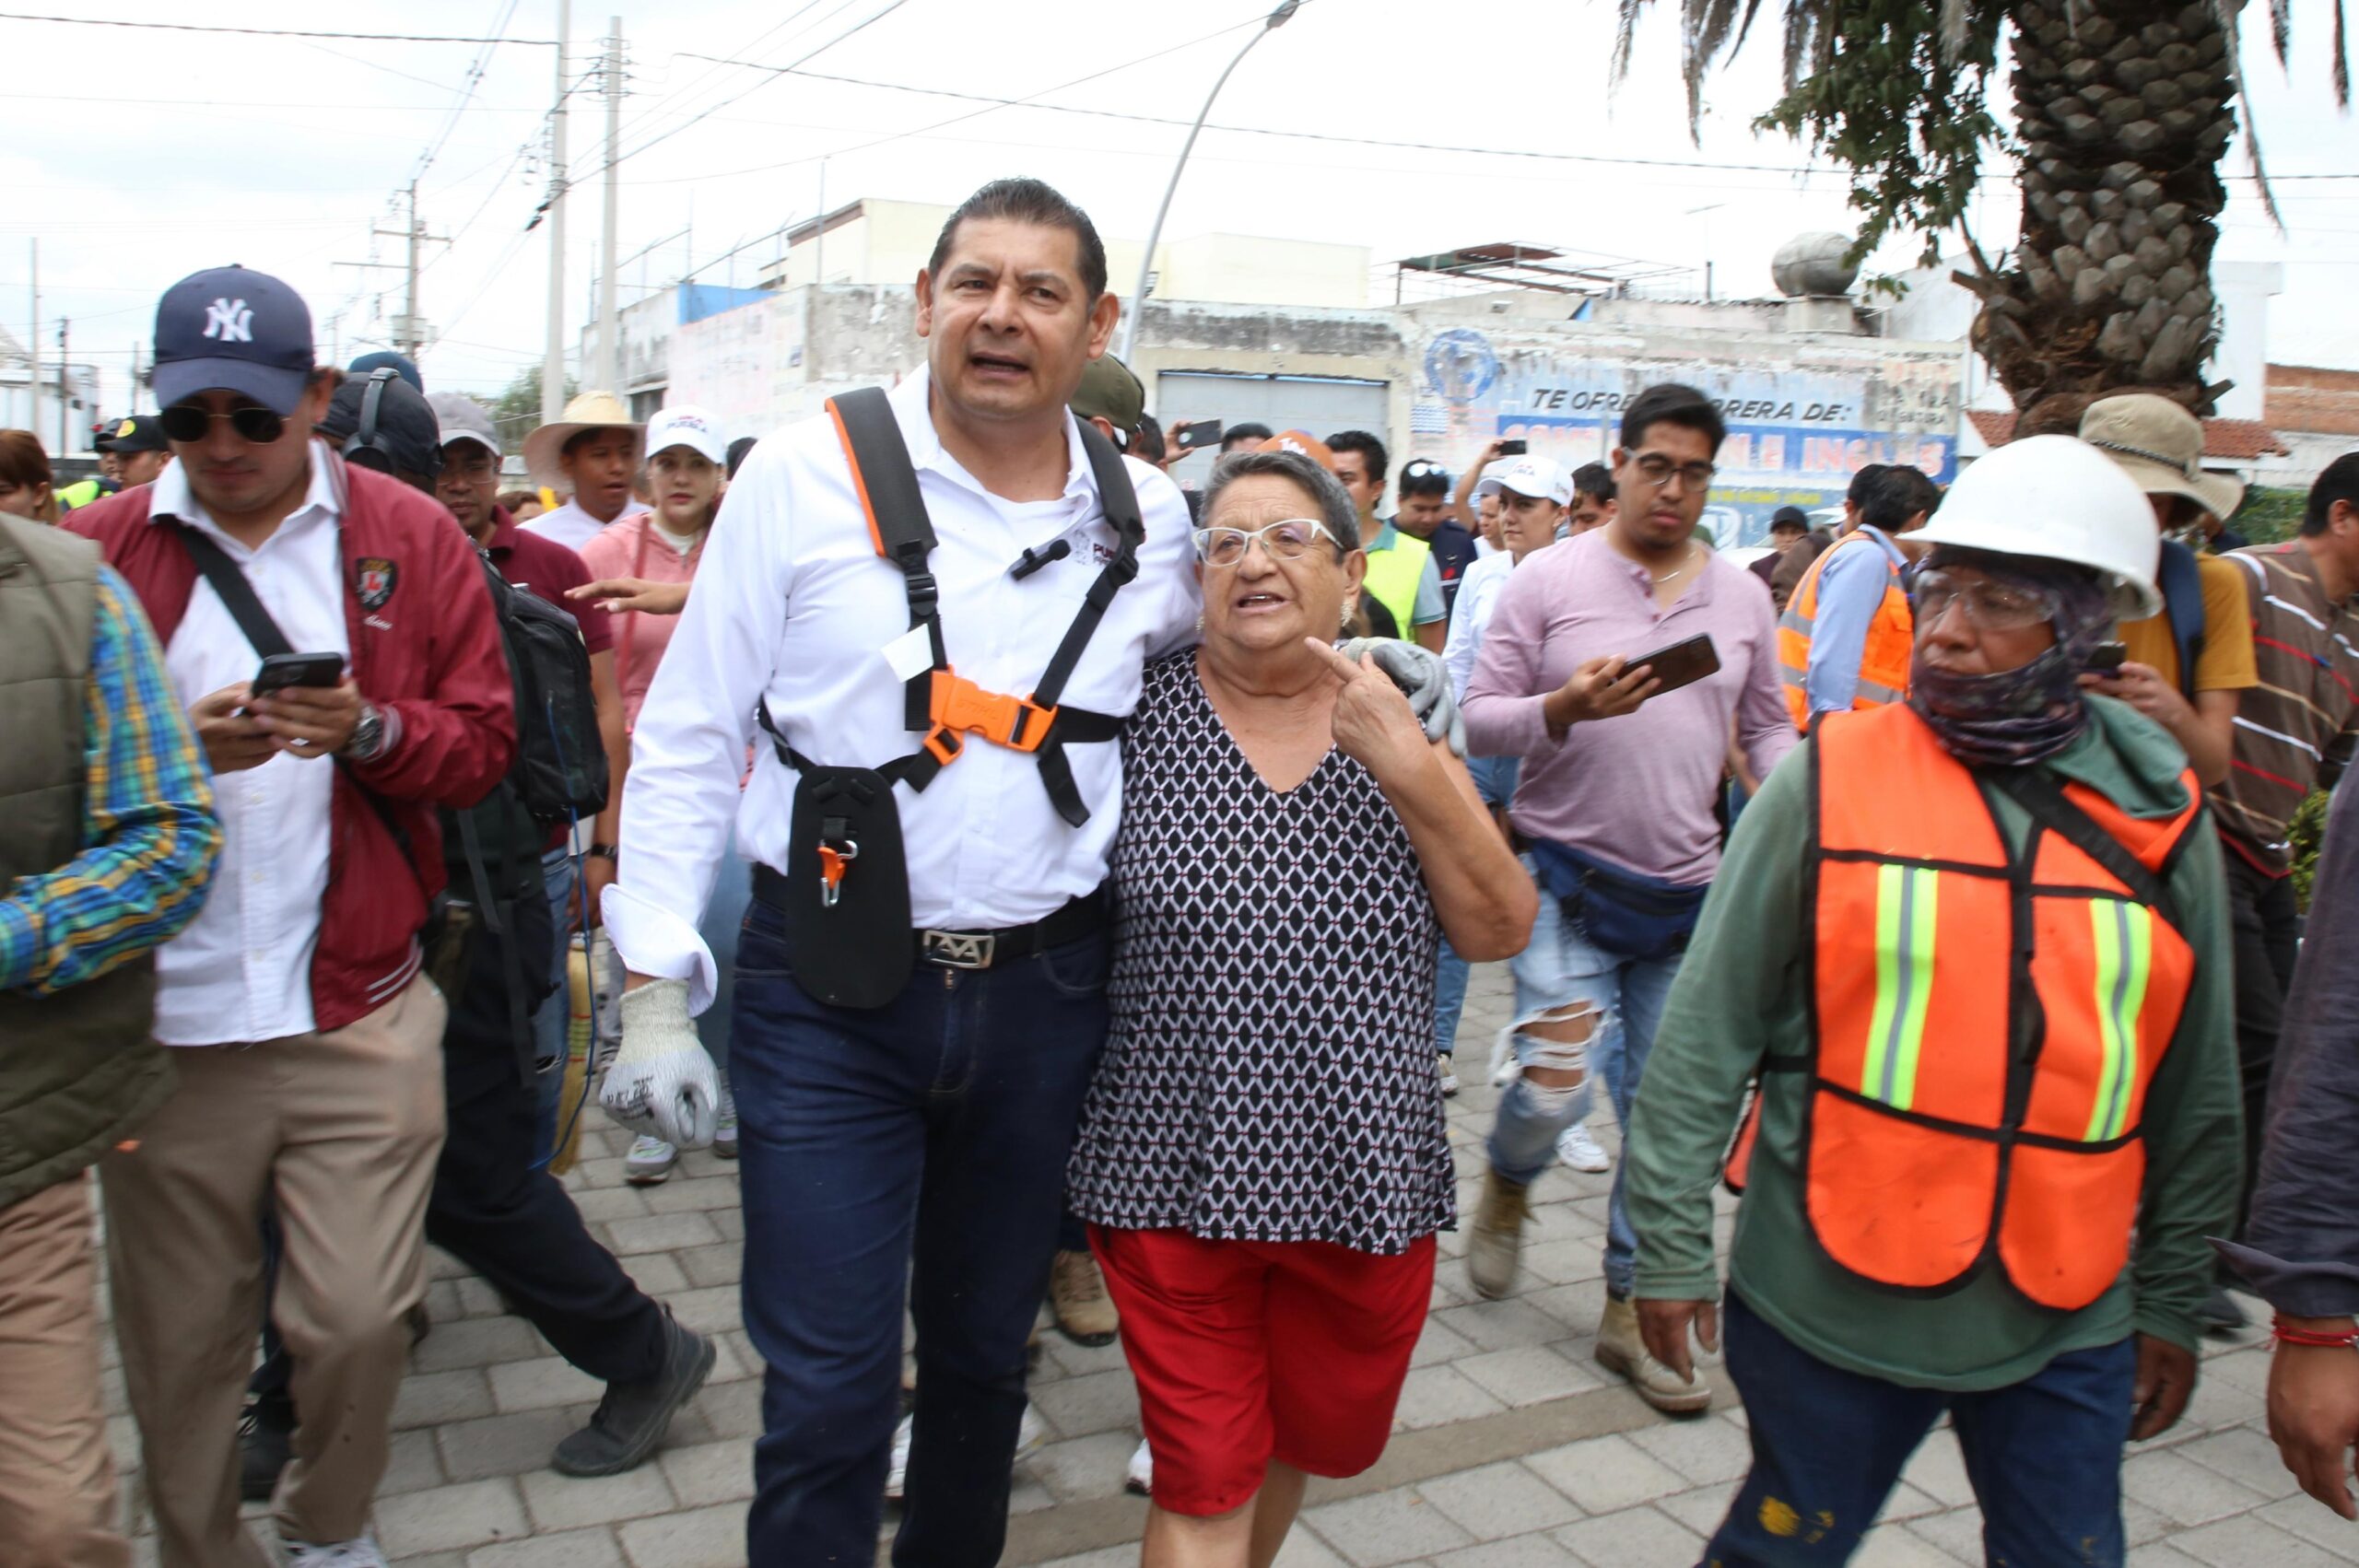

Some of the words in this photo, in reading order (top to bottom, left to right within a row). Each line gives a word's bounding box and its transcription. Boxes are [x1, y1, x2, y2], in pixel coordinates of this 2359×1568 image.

[202, 298, 254, 342] NY
[1532, 388, 1569, 410] TE
[1571, 390, 1638, 413] OFRE
[1709, 398, 1794, 420] RRERA
[1802, 403, 1852, 422] DE:
